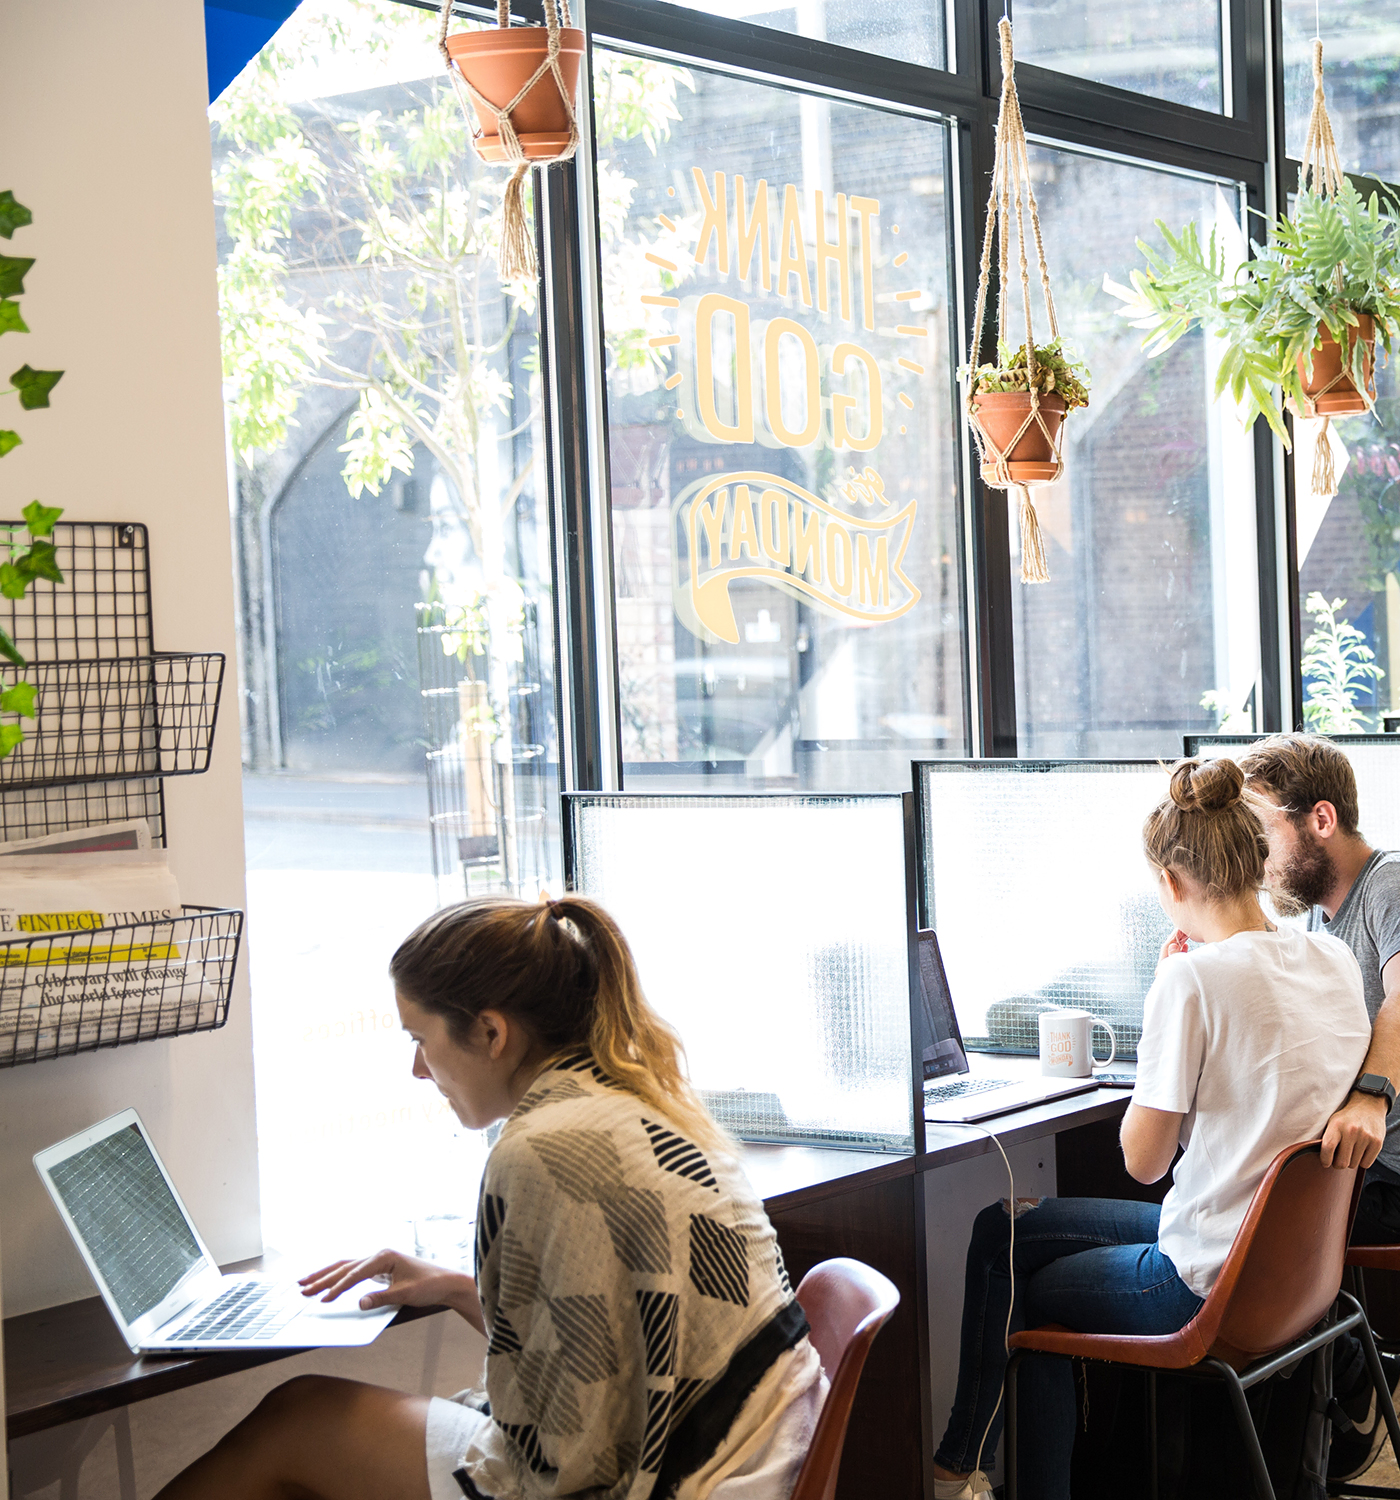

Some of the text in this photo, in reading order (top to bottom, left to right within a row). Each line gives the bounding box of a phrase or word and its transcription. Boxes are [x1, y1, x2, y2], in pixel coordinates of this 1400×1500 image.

[16, 912, 105, 932] FINTECH
[108, 909, 172, 928] TIMES
[35, 972, 110, 992] Cyberwars
[112, 968, 138, 984] will
[141, 966, 188, 981] change
[41, 991, 64, 1007] the
[67, 986, 109, 1005] world
[111, 984, 161, 999] forever
[1050, 1031, 1071, 1043] THANK
[1050, 1040, 1072, 1053] GOD
